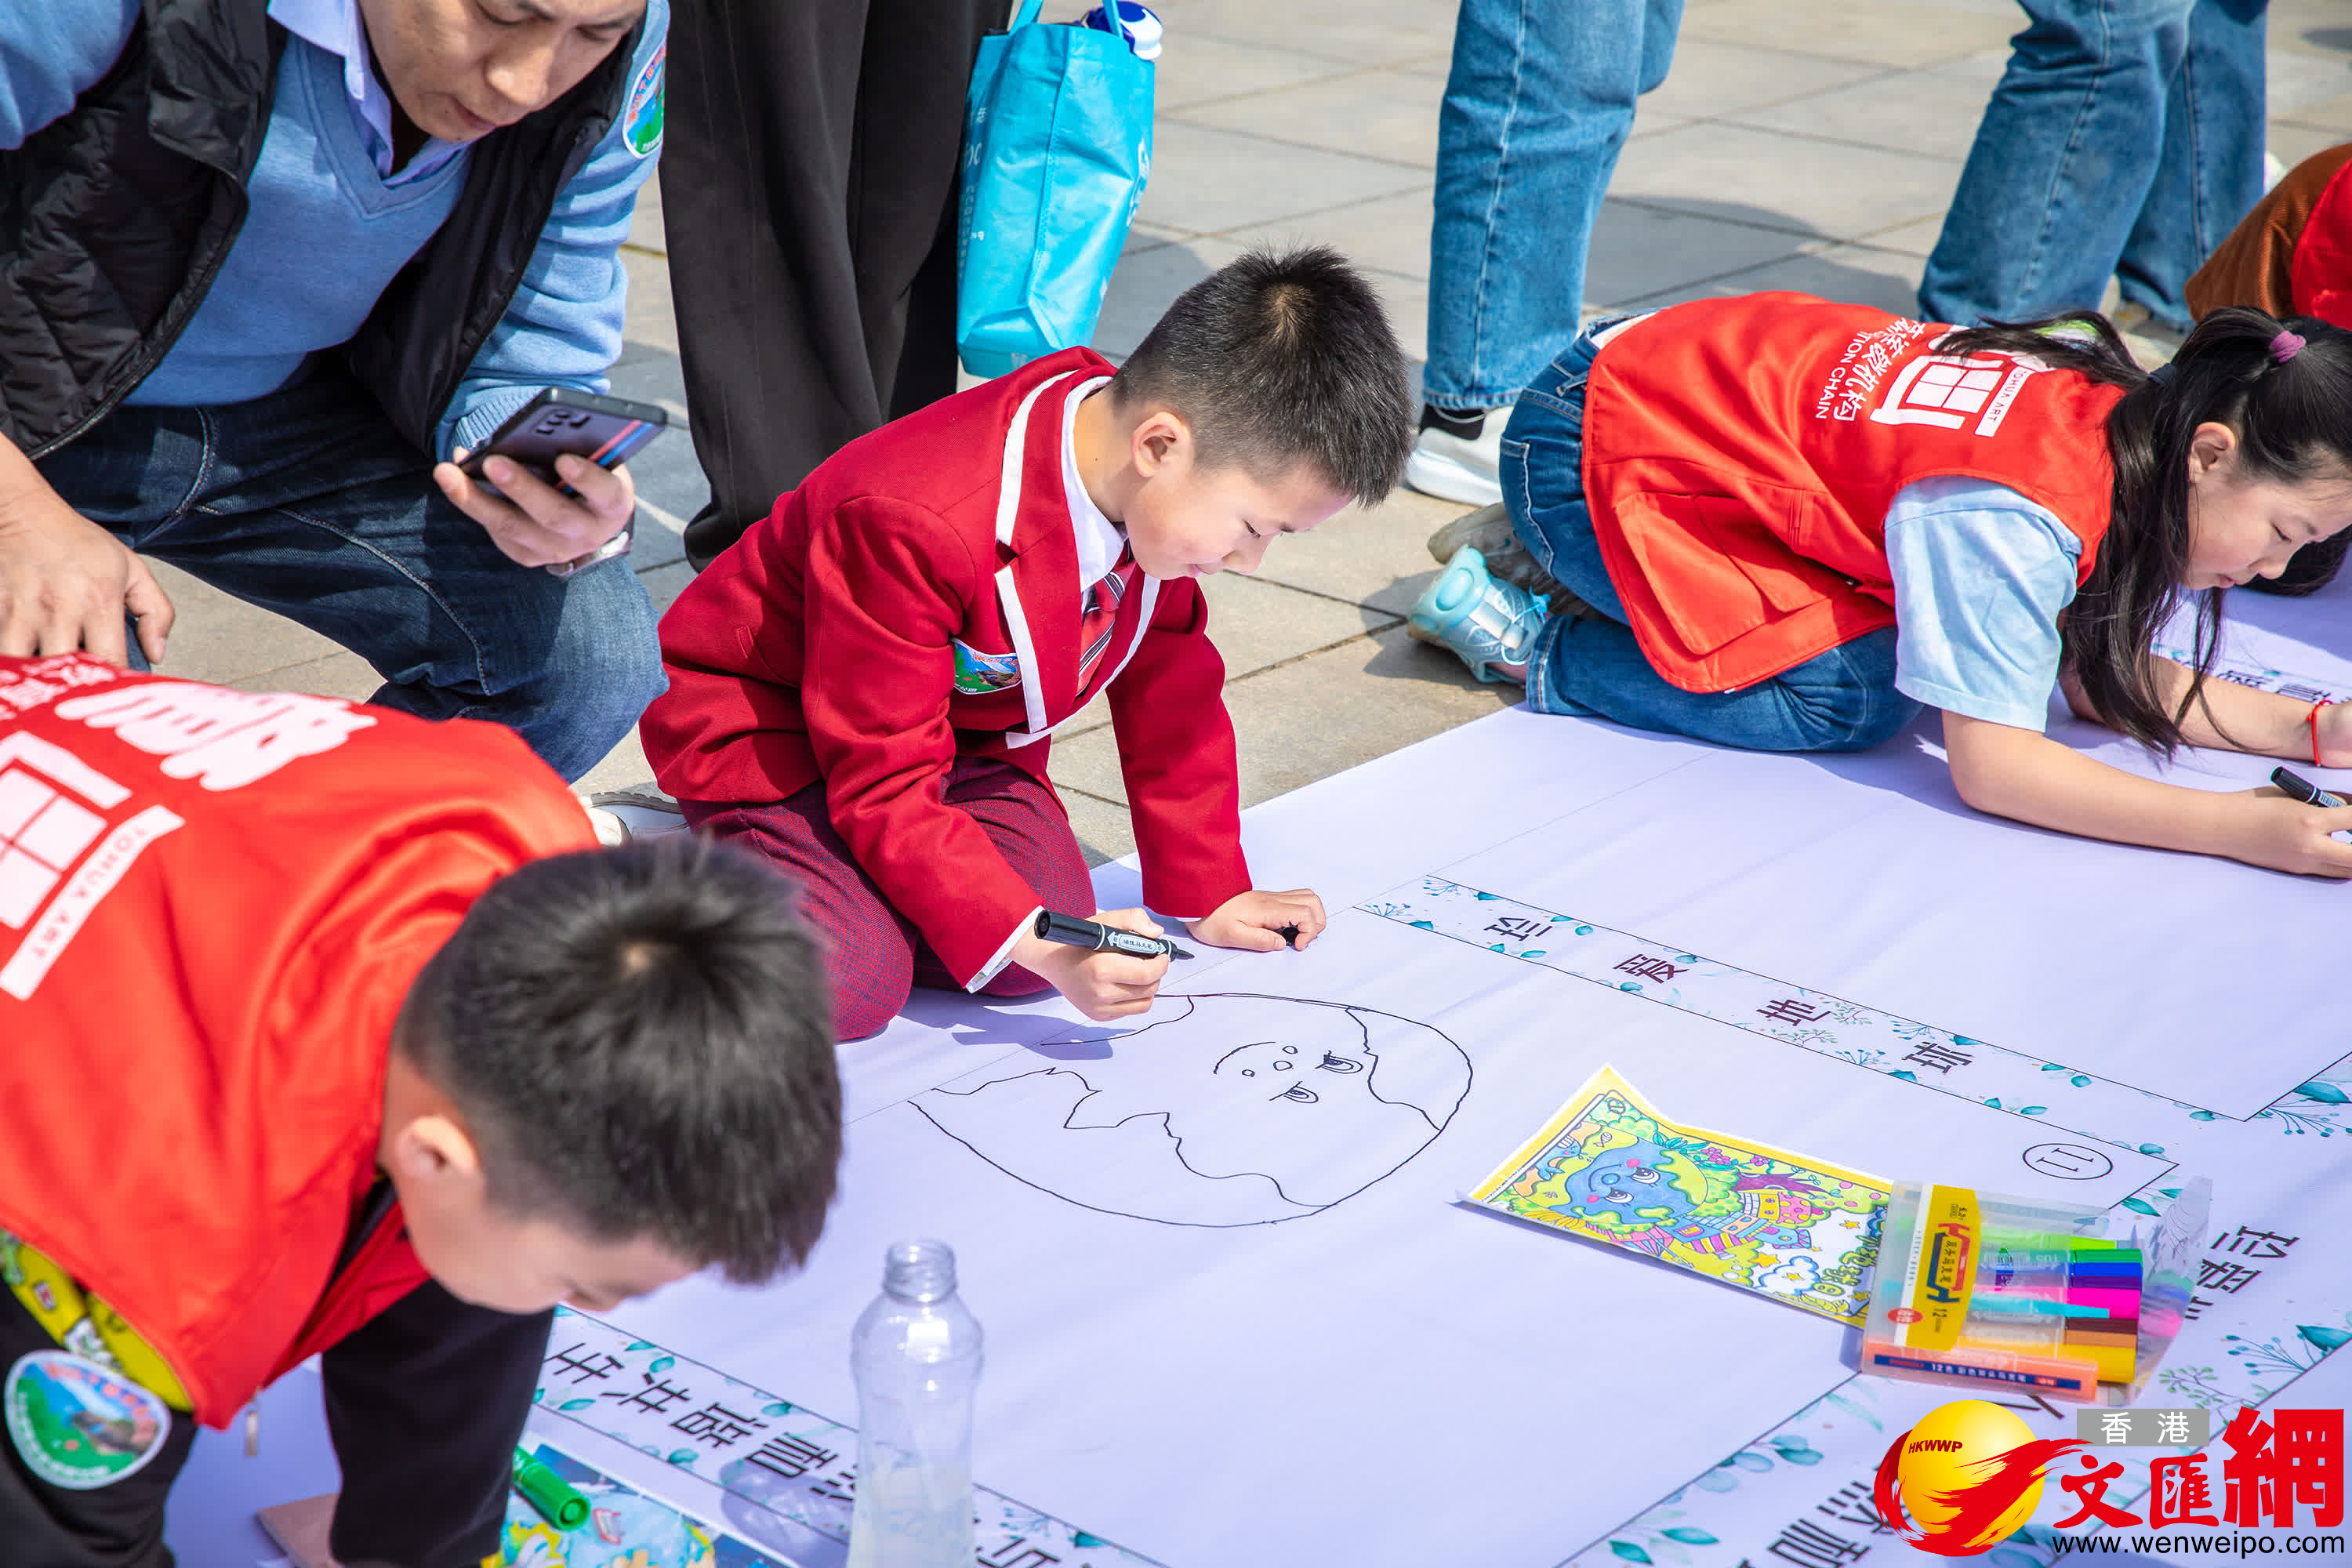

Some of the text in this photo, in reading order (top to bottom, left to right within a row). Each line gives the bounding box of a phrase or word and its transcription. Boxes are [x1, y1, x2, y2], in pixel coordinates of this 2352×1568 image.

[1815, 366, 1846, 419] CHAIN
[1987, 401, 2005, 423] ART
[31, 826, 149, 959] TOHUA ART
[1483, 914, 1973, 1074] 珍爱地球
